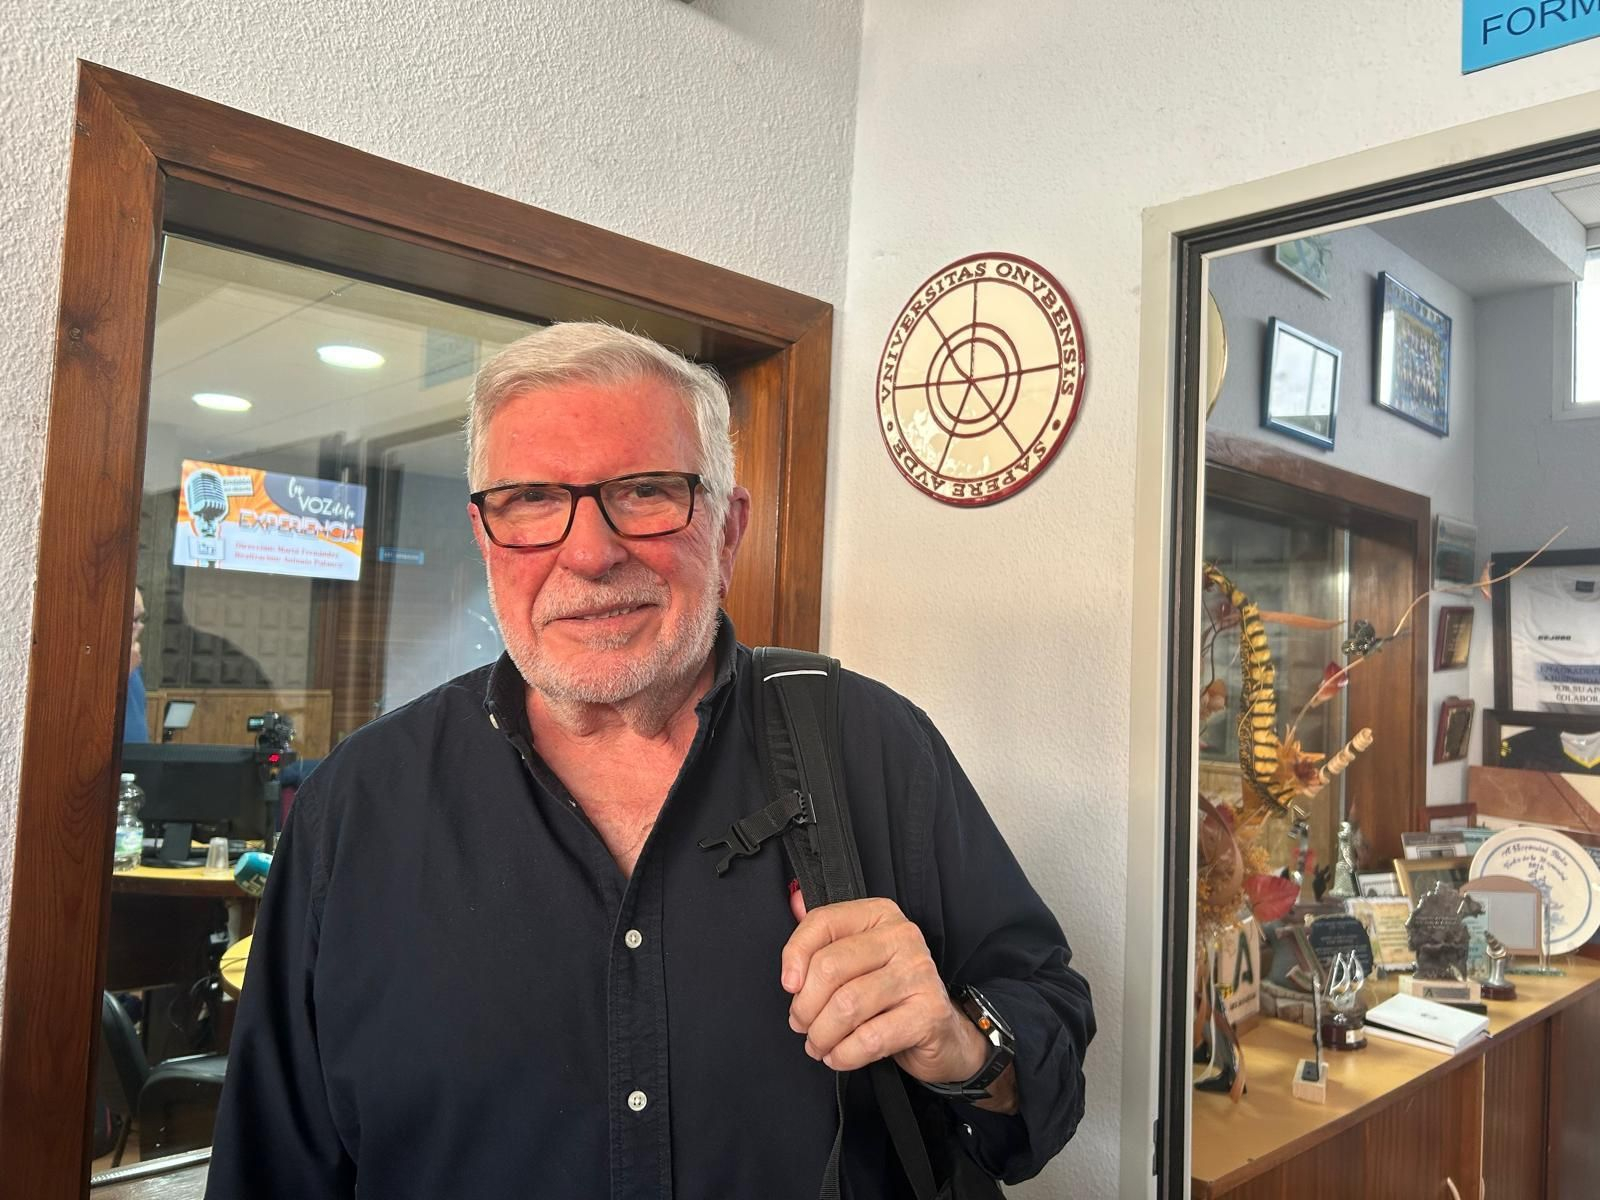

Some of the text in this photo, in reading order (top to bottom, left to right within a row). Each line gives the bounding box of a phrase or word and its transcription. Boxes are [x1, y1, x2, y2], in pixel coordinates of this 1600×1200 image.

[882, 262, 1077, 404] VNIVERSITAS ONVBENSIS
[892, 438, 1047, 497] SAPERE AVDE
[238, 508, 359, 543] EXPERIENCIA
[299, 496, 333, 516] VOZ
